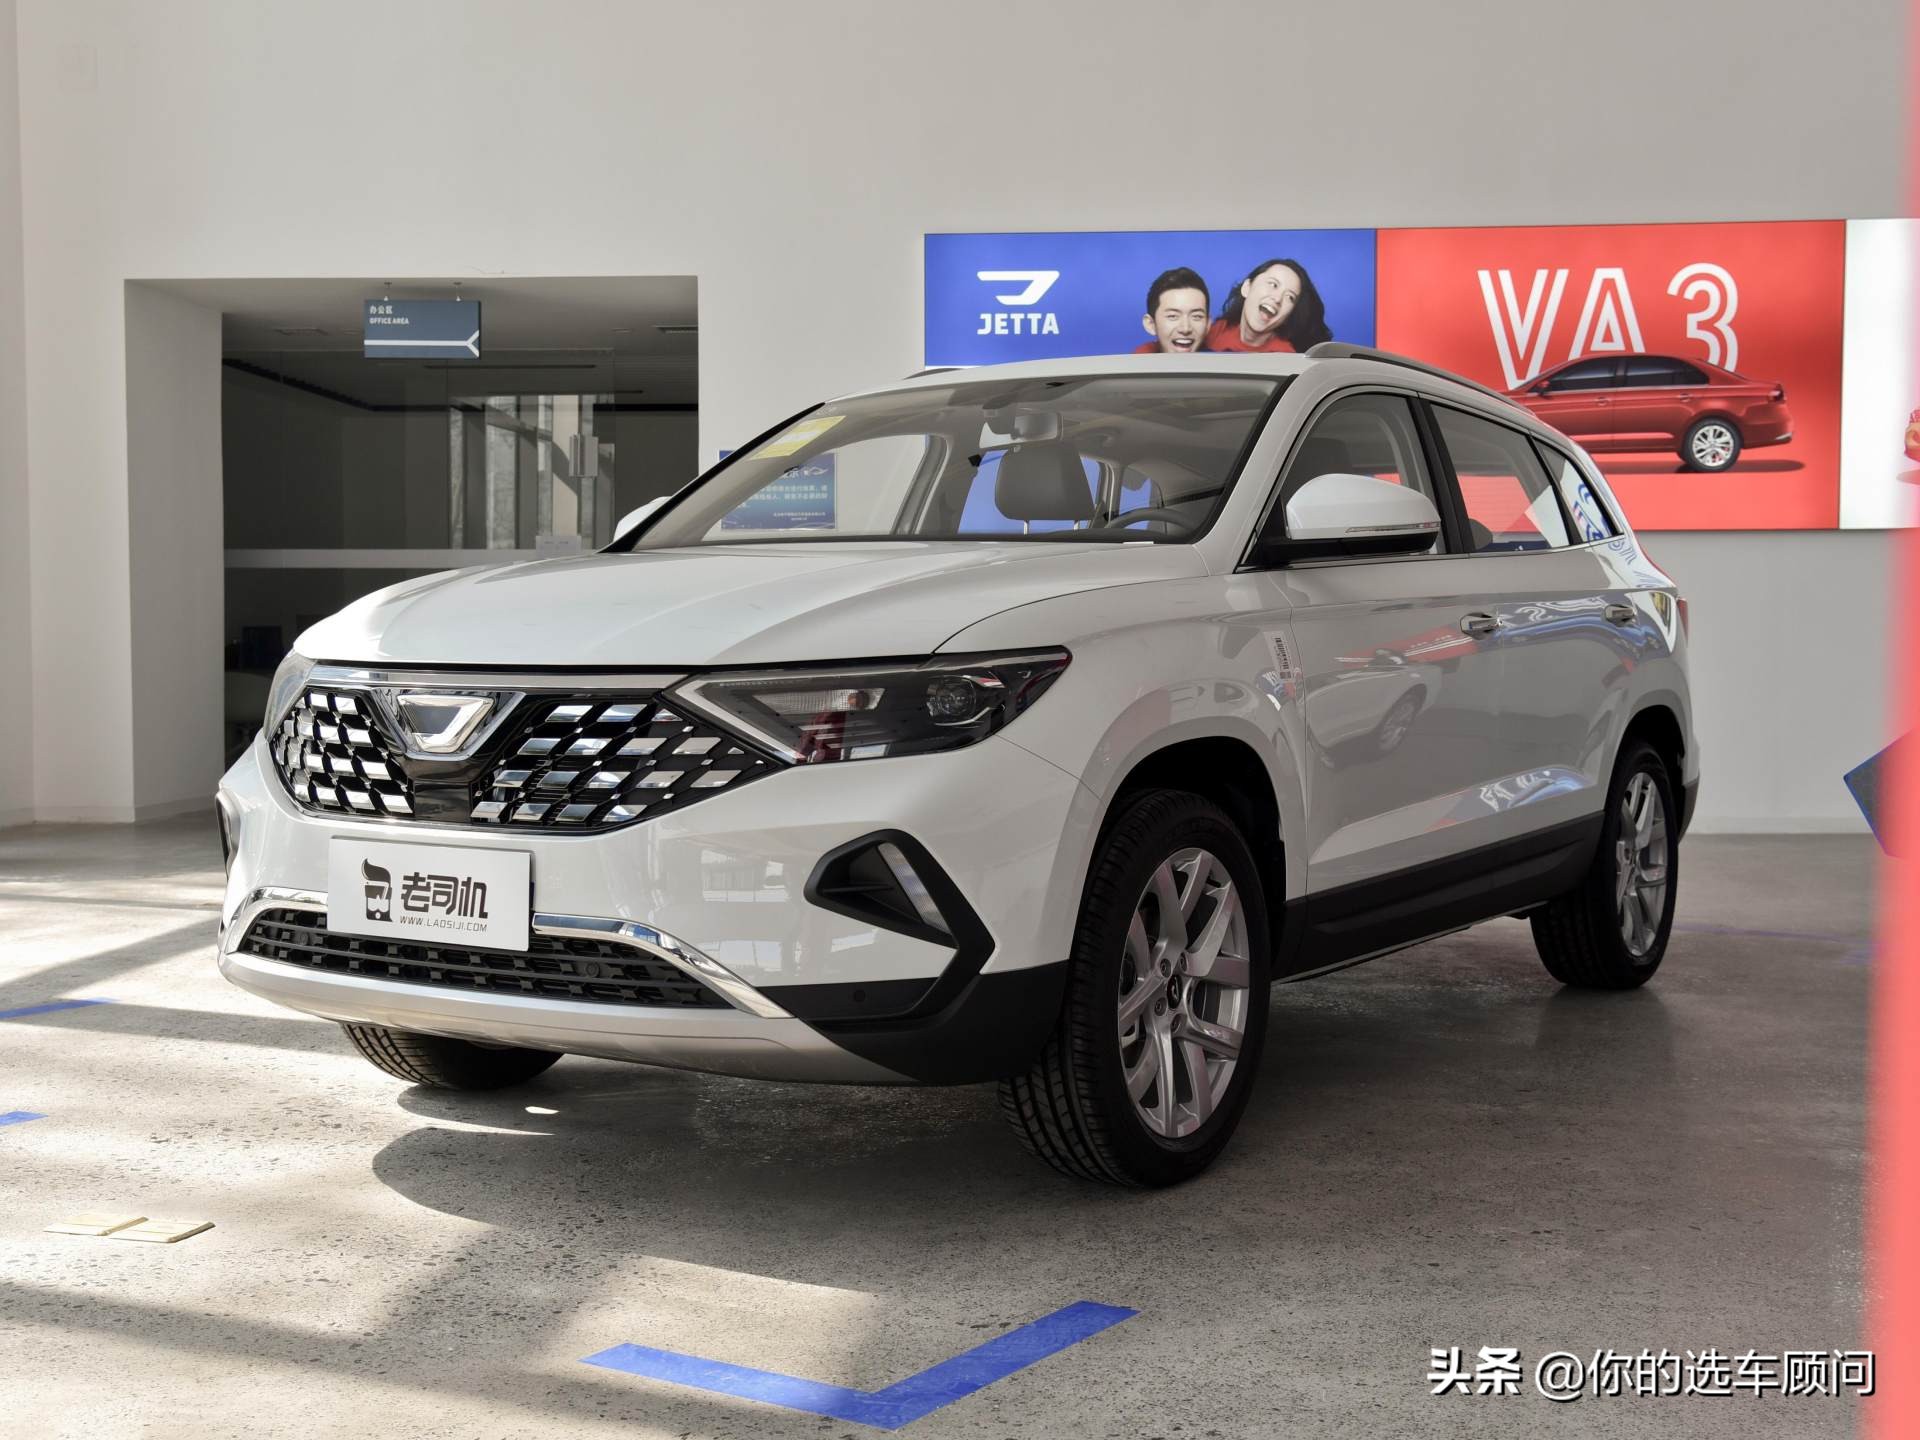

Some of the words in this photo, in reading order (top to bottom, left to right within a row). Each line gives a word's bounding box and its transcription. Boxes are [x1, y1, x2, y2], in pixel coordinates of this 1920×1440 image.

[369, 305, 393, 315] 办公区
[369, 317, 392, 325] OFFICE
[392, 317, 410, 325] AREA
[976, 312, 1060, 335] JETTA
[1477, 267, 1646, 390] VA
[1667, 262, 1738, 372] 3
[400, 871, 489, 919] 老司机
[399, 915, 488, 932] WWW.LAOSIJI.COM
